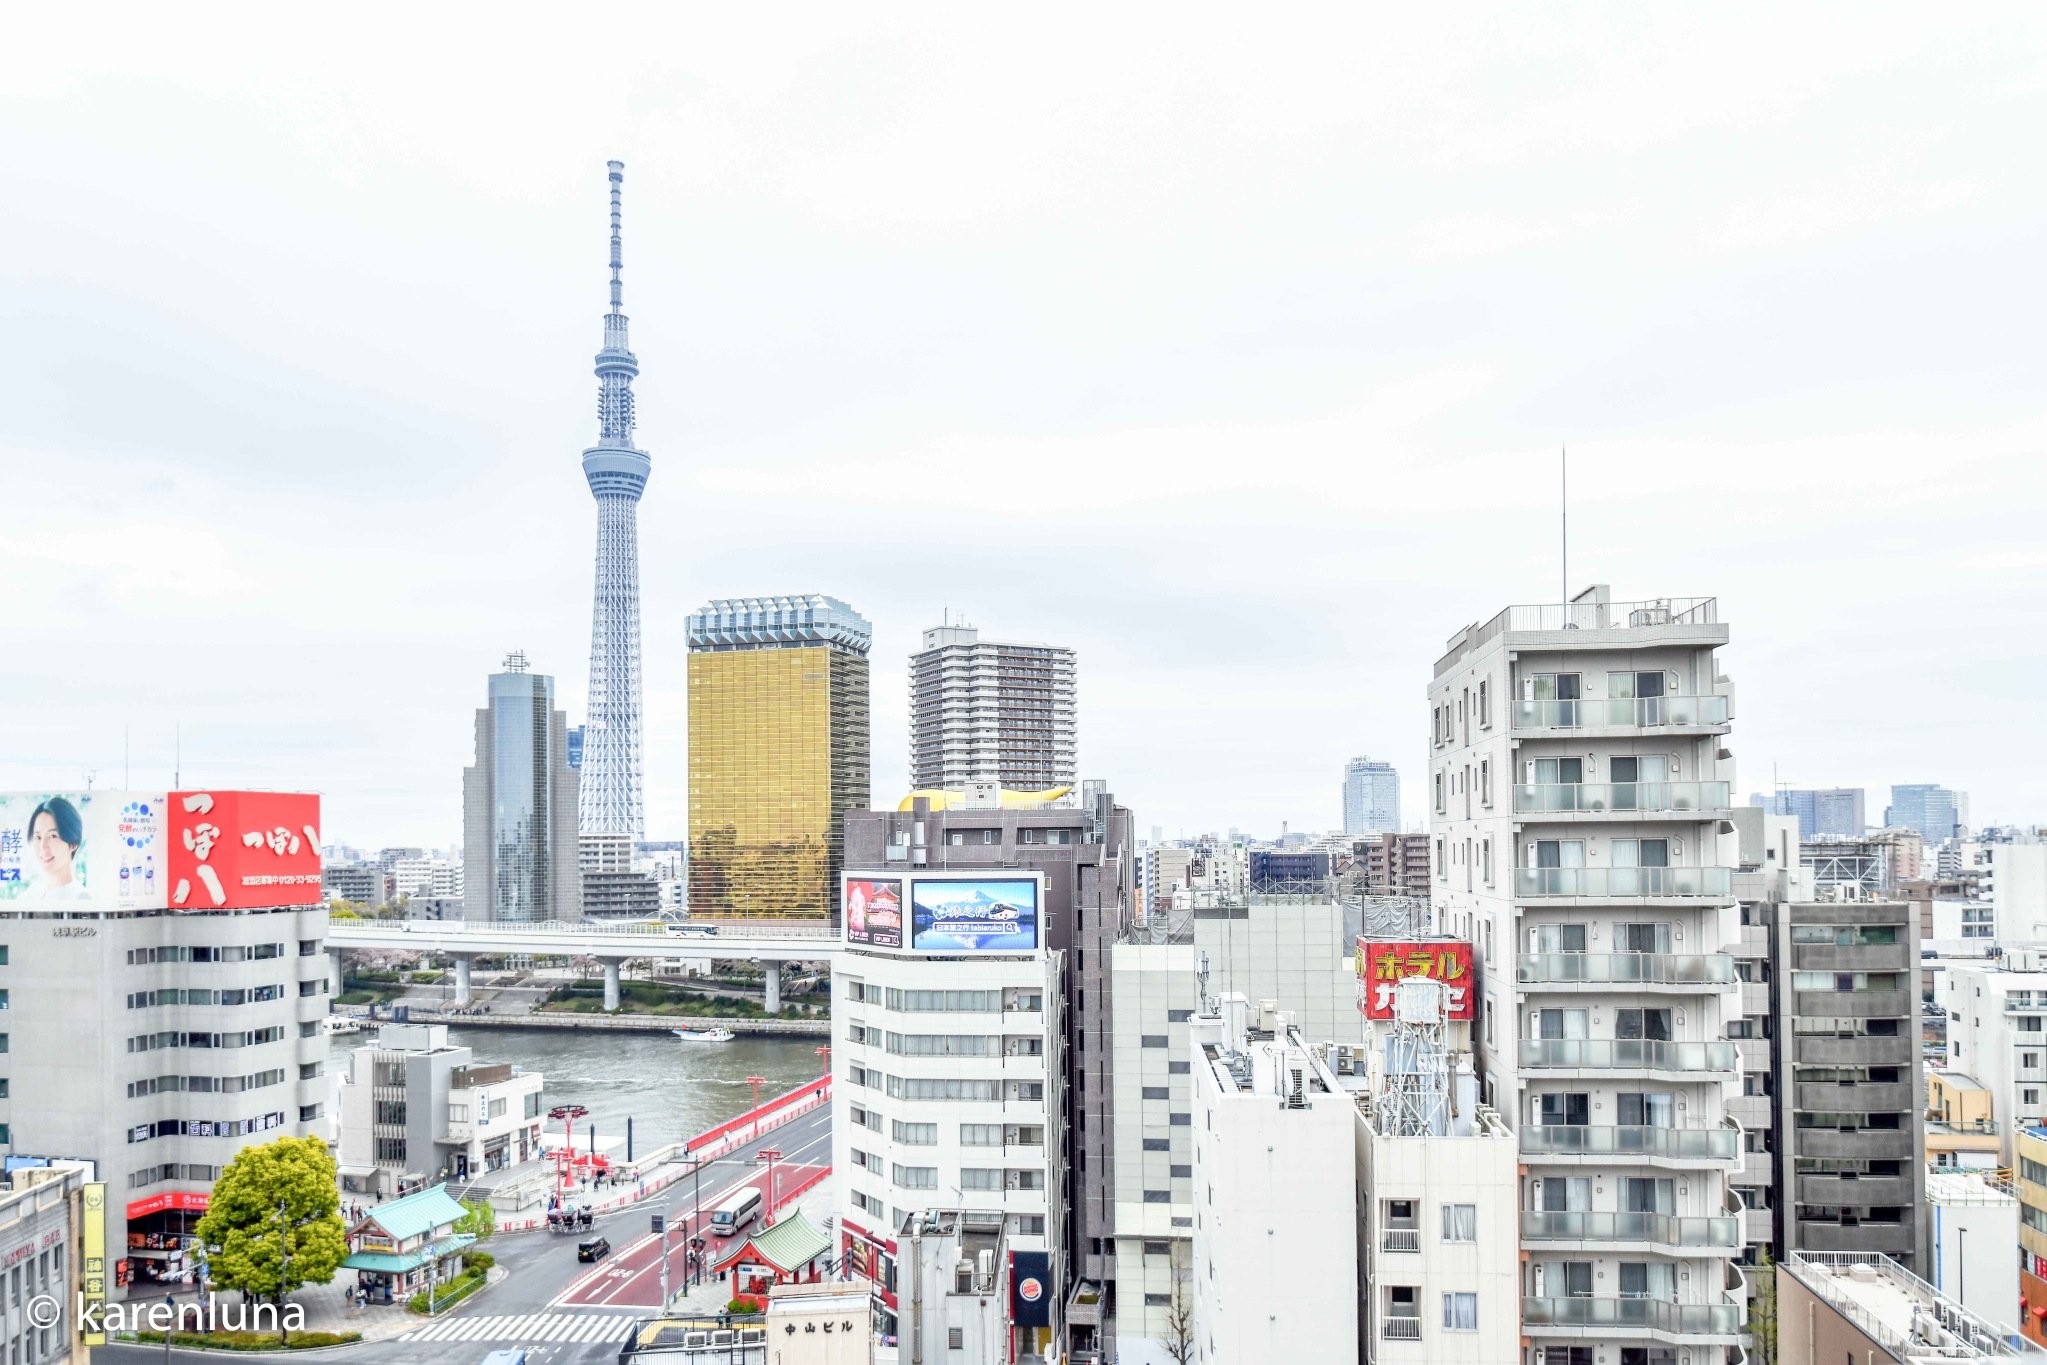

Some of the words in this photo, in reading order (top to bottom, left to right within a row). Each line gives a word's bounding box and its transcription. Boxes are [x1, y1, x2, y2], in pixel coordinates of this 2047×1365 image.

[173, 793, 226, 906] つぼ八
[242, 825, 321, 856] つぼ八
[1375, 952, 1465, 980] ホテル
[785, 1320, 853, 1335] 中山ビル
